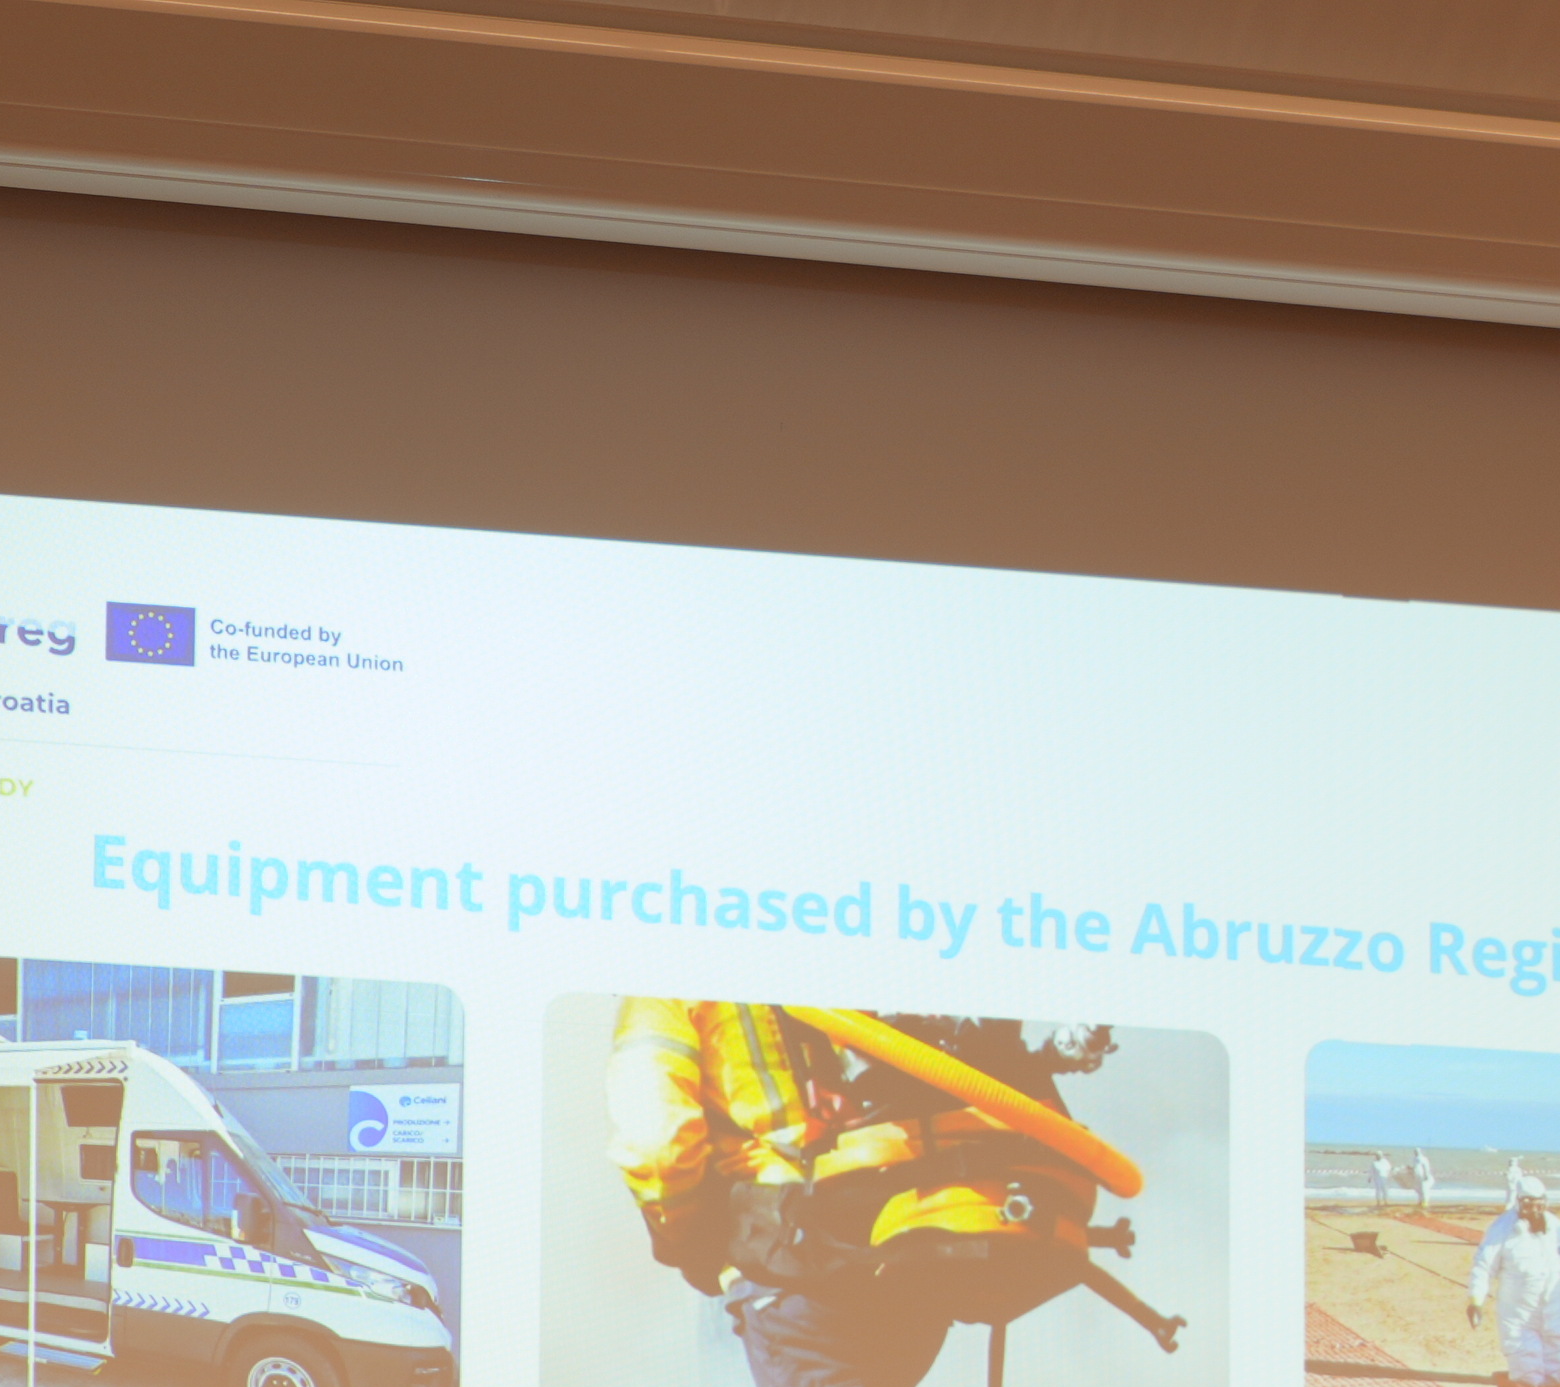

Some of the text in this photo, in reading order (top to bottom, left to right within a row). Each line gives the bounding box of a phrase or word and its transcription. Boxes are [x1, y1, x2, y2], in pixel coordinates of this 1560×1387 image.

[210, 618, 342, 647] Co-funded by
[209, 643, 405, 673] the European Union
[92, 834, 484, 916] Equipment
[508, 868, 874, 933] purchased
[897, 884, 977, 960] by
[997, 892, 1112, 955] the
[1130, 901, 1406, 974] Abruzzo
